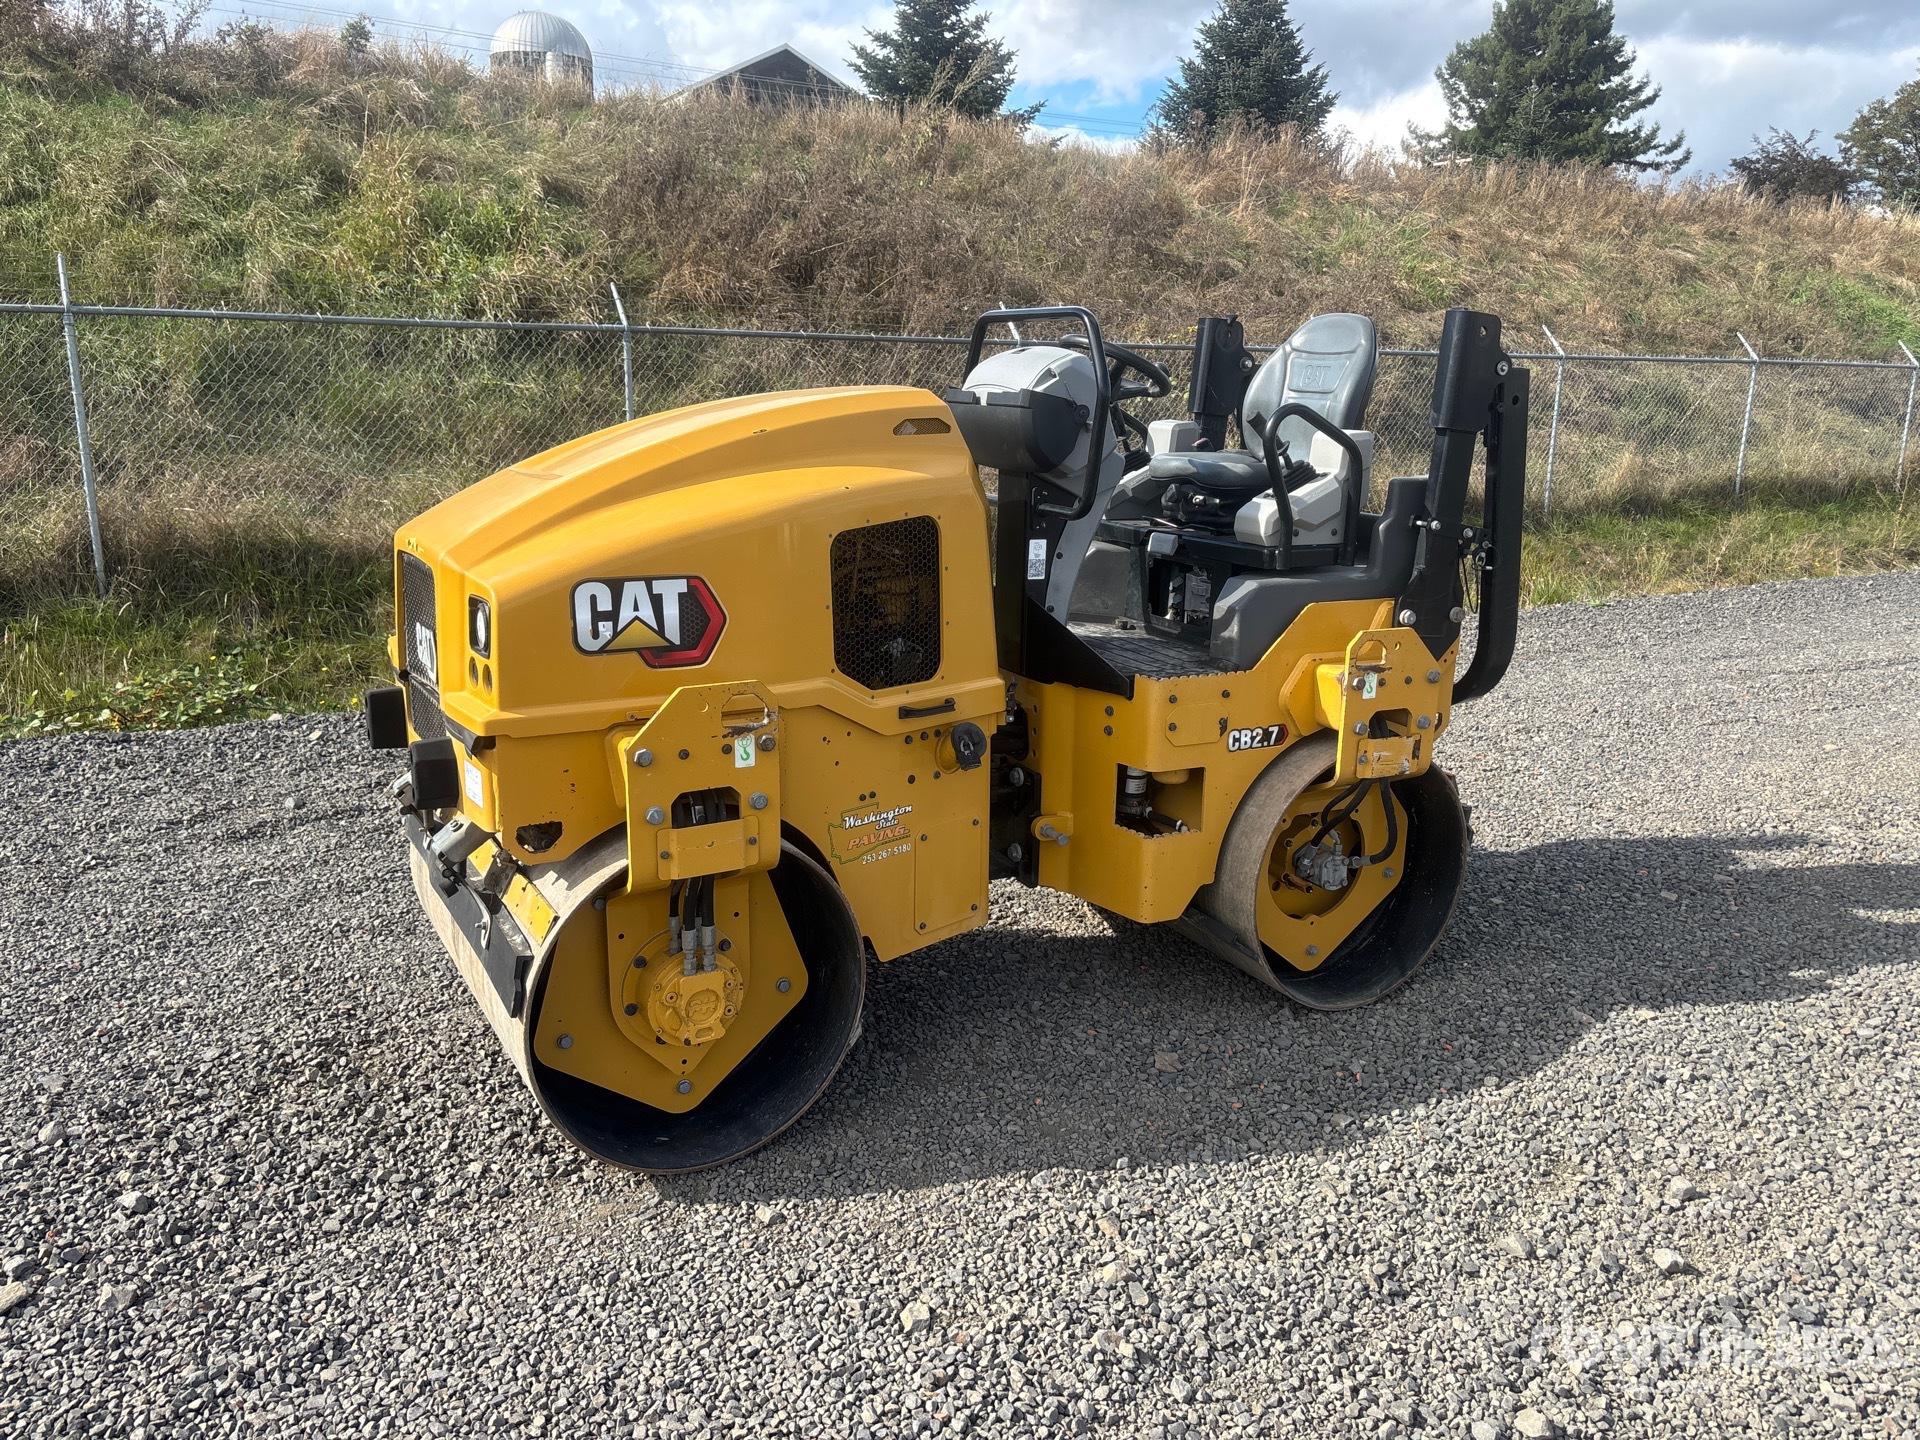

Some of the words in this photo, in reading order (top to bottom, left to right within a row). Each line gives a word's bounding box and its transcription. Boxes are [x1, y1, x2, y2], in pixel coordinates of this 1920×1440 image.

[1297, 364, 1331, 388] CAT
[574, 578, 688, 652] CAT
[1228, 726, 1279, 752] CB2.7
[843, 805, 913, 830] Washington
[875, 817, 899, 830] State
[847, 825, 906, 851] PAVING
[862, 843, 912, 864] 253.267.5180
